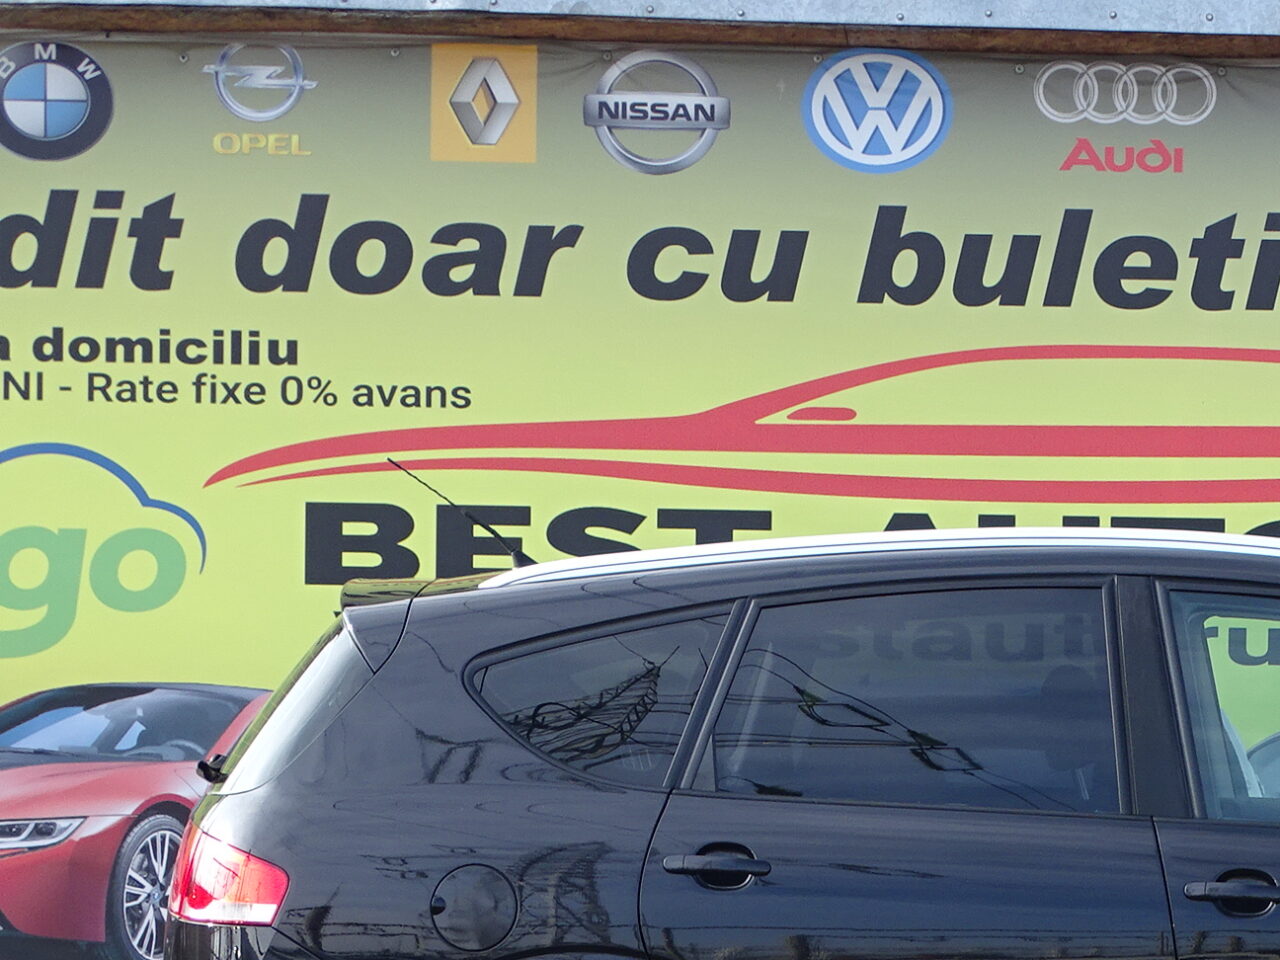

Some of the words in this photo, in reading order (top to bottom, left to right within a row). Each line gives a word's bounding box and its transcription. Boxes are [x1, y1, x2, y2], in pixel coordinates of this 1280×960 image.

[0, 43, 101, 81] BMW
[599, 100, 717, 123] NISSAN
[212, 133, 312, 157] OPEL
[1059, 137, 1184, 174] Audi
[0, 188, 185, 292] dit
[234, 193, 585, 298] doar
[626, 225, 810, 304] cu
[31, 326, 300, 366] domiciliu
[86, 372, 179, 404] Rate
[191, 372, 267, 406] fixe
[280, 375, 338, 407] 0%
[352, 383, 473, 409] avans
